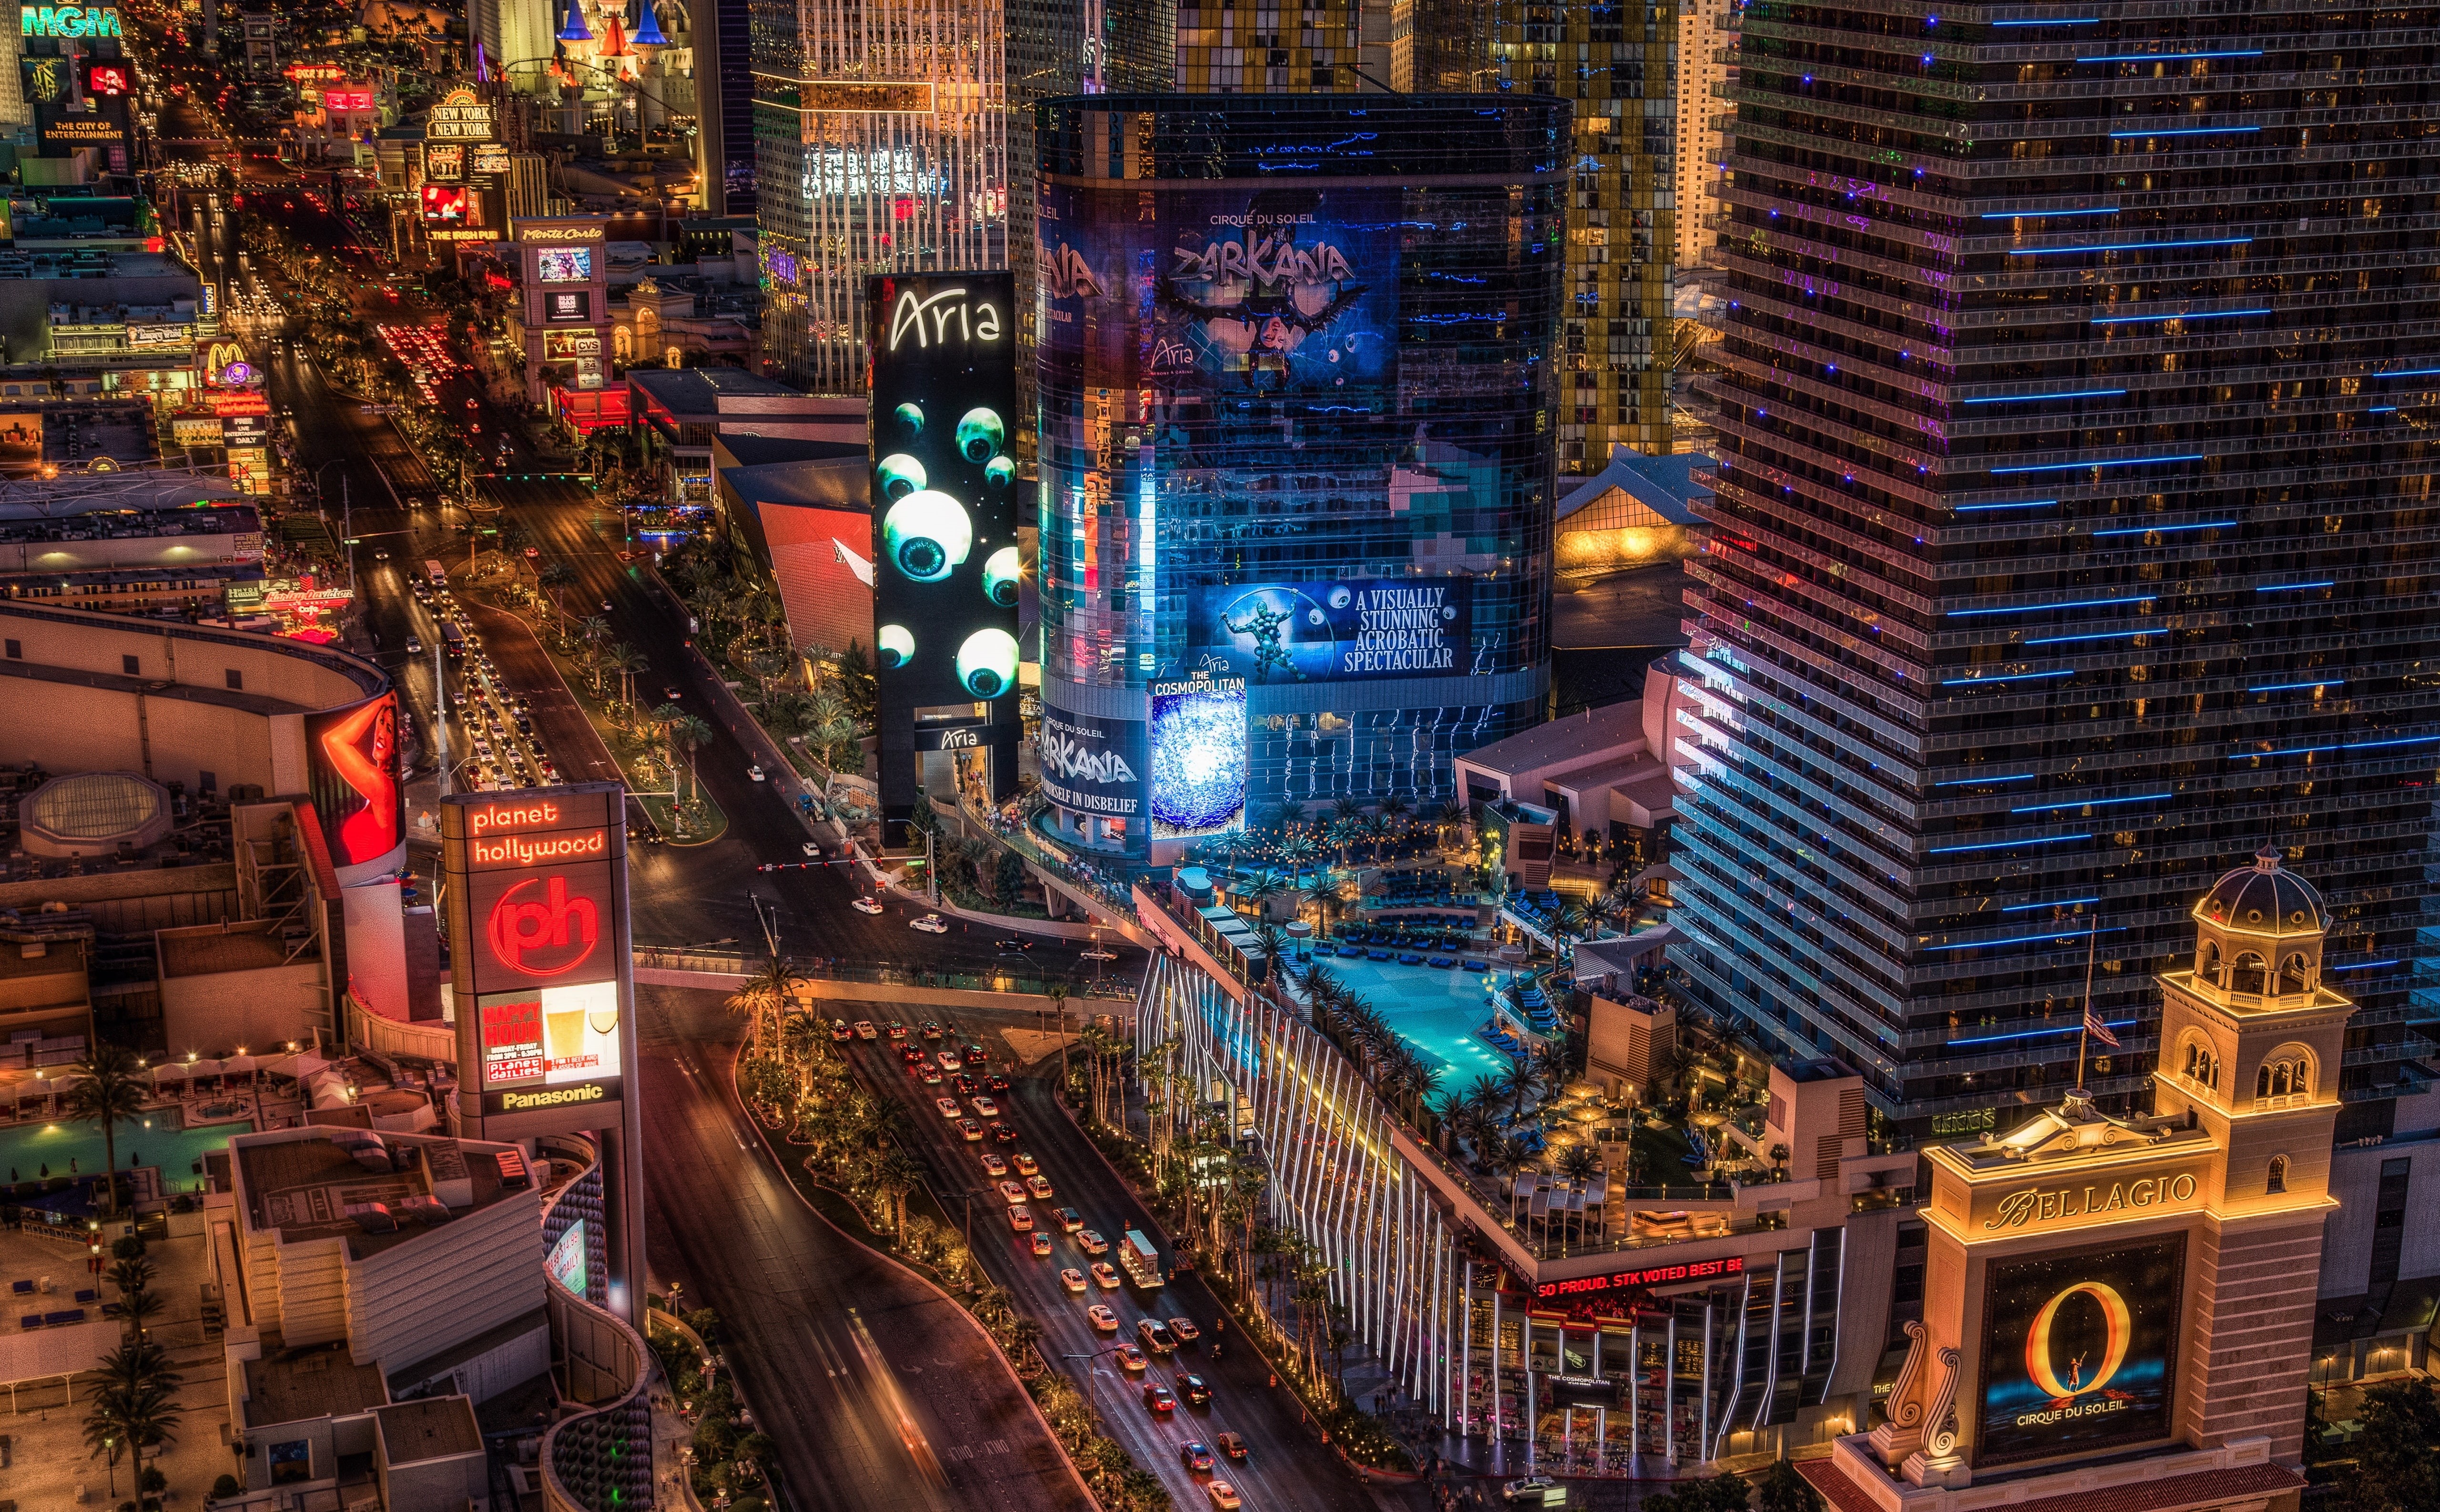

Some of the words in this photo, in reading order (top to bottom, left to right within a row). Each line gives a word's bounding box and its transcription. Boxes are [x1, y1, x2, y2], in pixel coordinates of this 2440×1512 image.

[21, 6, 122, 38] MGM
[434, 107, 459, 120] NEW
[459, 107, 491, 120] YORK
[45, 130, 123, 139] ENTERTAINMENT
[55, 122, 76, 130] THE
[76, 122, 96, 130] CITY
[97, 122, 112, 130] OF
[435, 123, 460, 136] NEW
[461, 122, 492, 136] YORK
[1210, 214, 1253, 228] CIRQUE
[1257, 214, 1273, 224] DU
[1277, 214, 1317, 224] SOLEIL
[431, 231, 452, 240] THE
[452, 230, 478, 240] IRISH
[478, 230, 498, 240] PUB
[522, 229, 564, 240] Monte
[564, 227, 603, 240] Carlo
[1168, 230, 1355, 292] ZARKANA
[890, 288, 1000, 351] Aria
[579, 341, 599, 350] CVS
[1151, 339, 1193, 369] Aria
[116, 375, 174, 386] Walgreens
[1356, 591, 1370, 611] A
[1371, 588, 1444, 610] VISUALLY
[1360, 609, 1438, 631] STUNNING
[1356, 629, 1444, 650] ACROBATIC
[1199, 653, 1229, 673] Aria
[1344, 648, 1453, 672] SPECTACULAR
[1191, 670, 1210, 680] THE
[1155, 678, 1245, 696] COSMOPOLITAN
[1046, 715, 1064, 731] CIRQUE
[1065, 723, 1075, 733] DU
[1076, 727, 1105, 738] SOLEIL
[941, 729, 977, 750] Aria
[1043, 778, 1071, 803] YOURSELF
[1072, 791, 1082, 807] IN
[1084, 794, 1138, 813] DISBELIEF
[473, 803, 557, 834] planet
[475, 831, 602, 863] hollywood
[501, 876, 597, 963] ph
[482, 1000, 541, 1025] HAPPY
[484, 1020, 542, 1047] HOUR
[486, 1053, 503, 1061] FROM
[503, 1052, 517, 1060] 3PM
[521, 1048, 543, 1058] 6:30PM
[491, 1042, 538, 1054] MONDAY-FRIDAY
[551, 1063, 575, 1071] GLASSES
[503, 1083, 603, 1109] Panasonic
[1983, 1174, 2196, 1231] BELLAGIO
[562, 1251, 579, 1278] DAILY
[1500, 1249, 1514, 1270] OUR
[1514, 1263, 1530, 1286] MOM
[1531, 1279, 1537, 1293] IS
[1538, 1283, 1556, 1298] SO
[1559, 1277, 1610, 1295] PROUD.
[1613, 1273, 1640, 1286] STK
[1642, 1267, 1686, 1282] VOTED
[1689, 1260, 1723, 1277] BEST
[2024, 1281, 2131, 1399] O
[1562, 1376, 1610, 1386] COSMOPOLITAN
[1873, 1383, 1891, 1394] THE
[2017, 1408, 2063, 1427] CIRQUE
[2065, 1406, 2083, 1420] DU
[947, 1445, 974, 1461] ONLY
[984, 1439, 1010, 1456] ONLY
